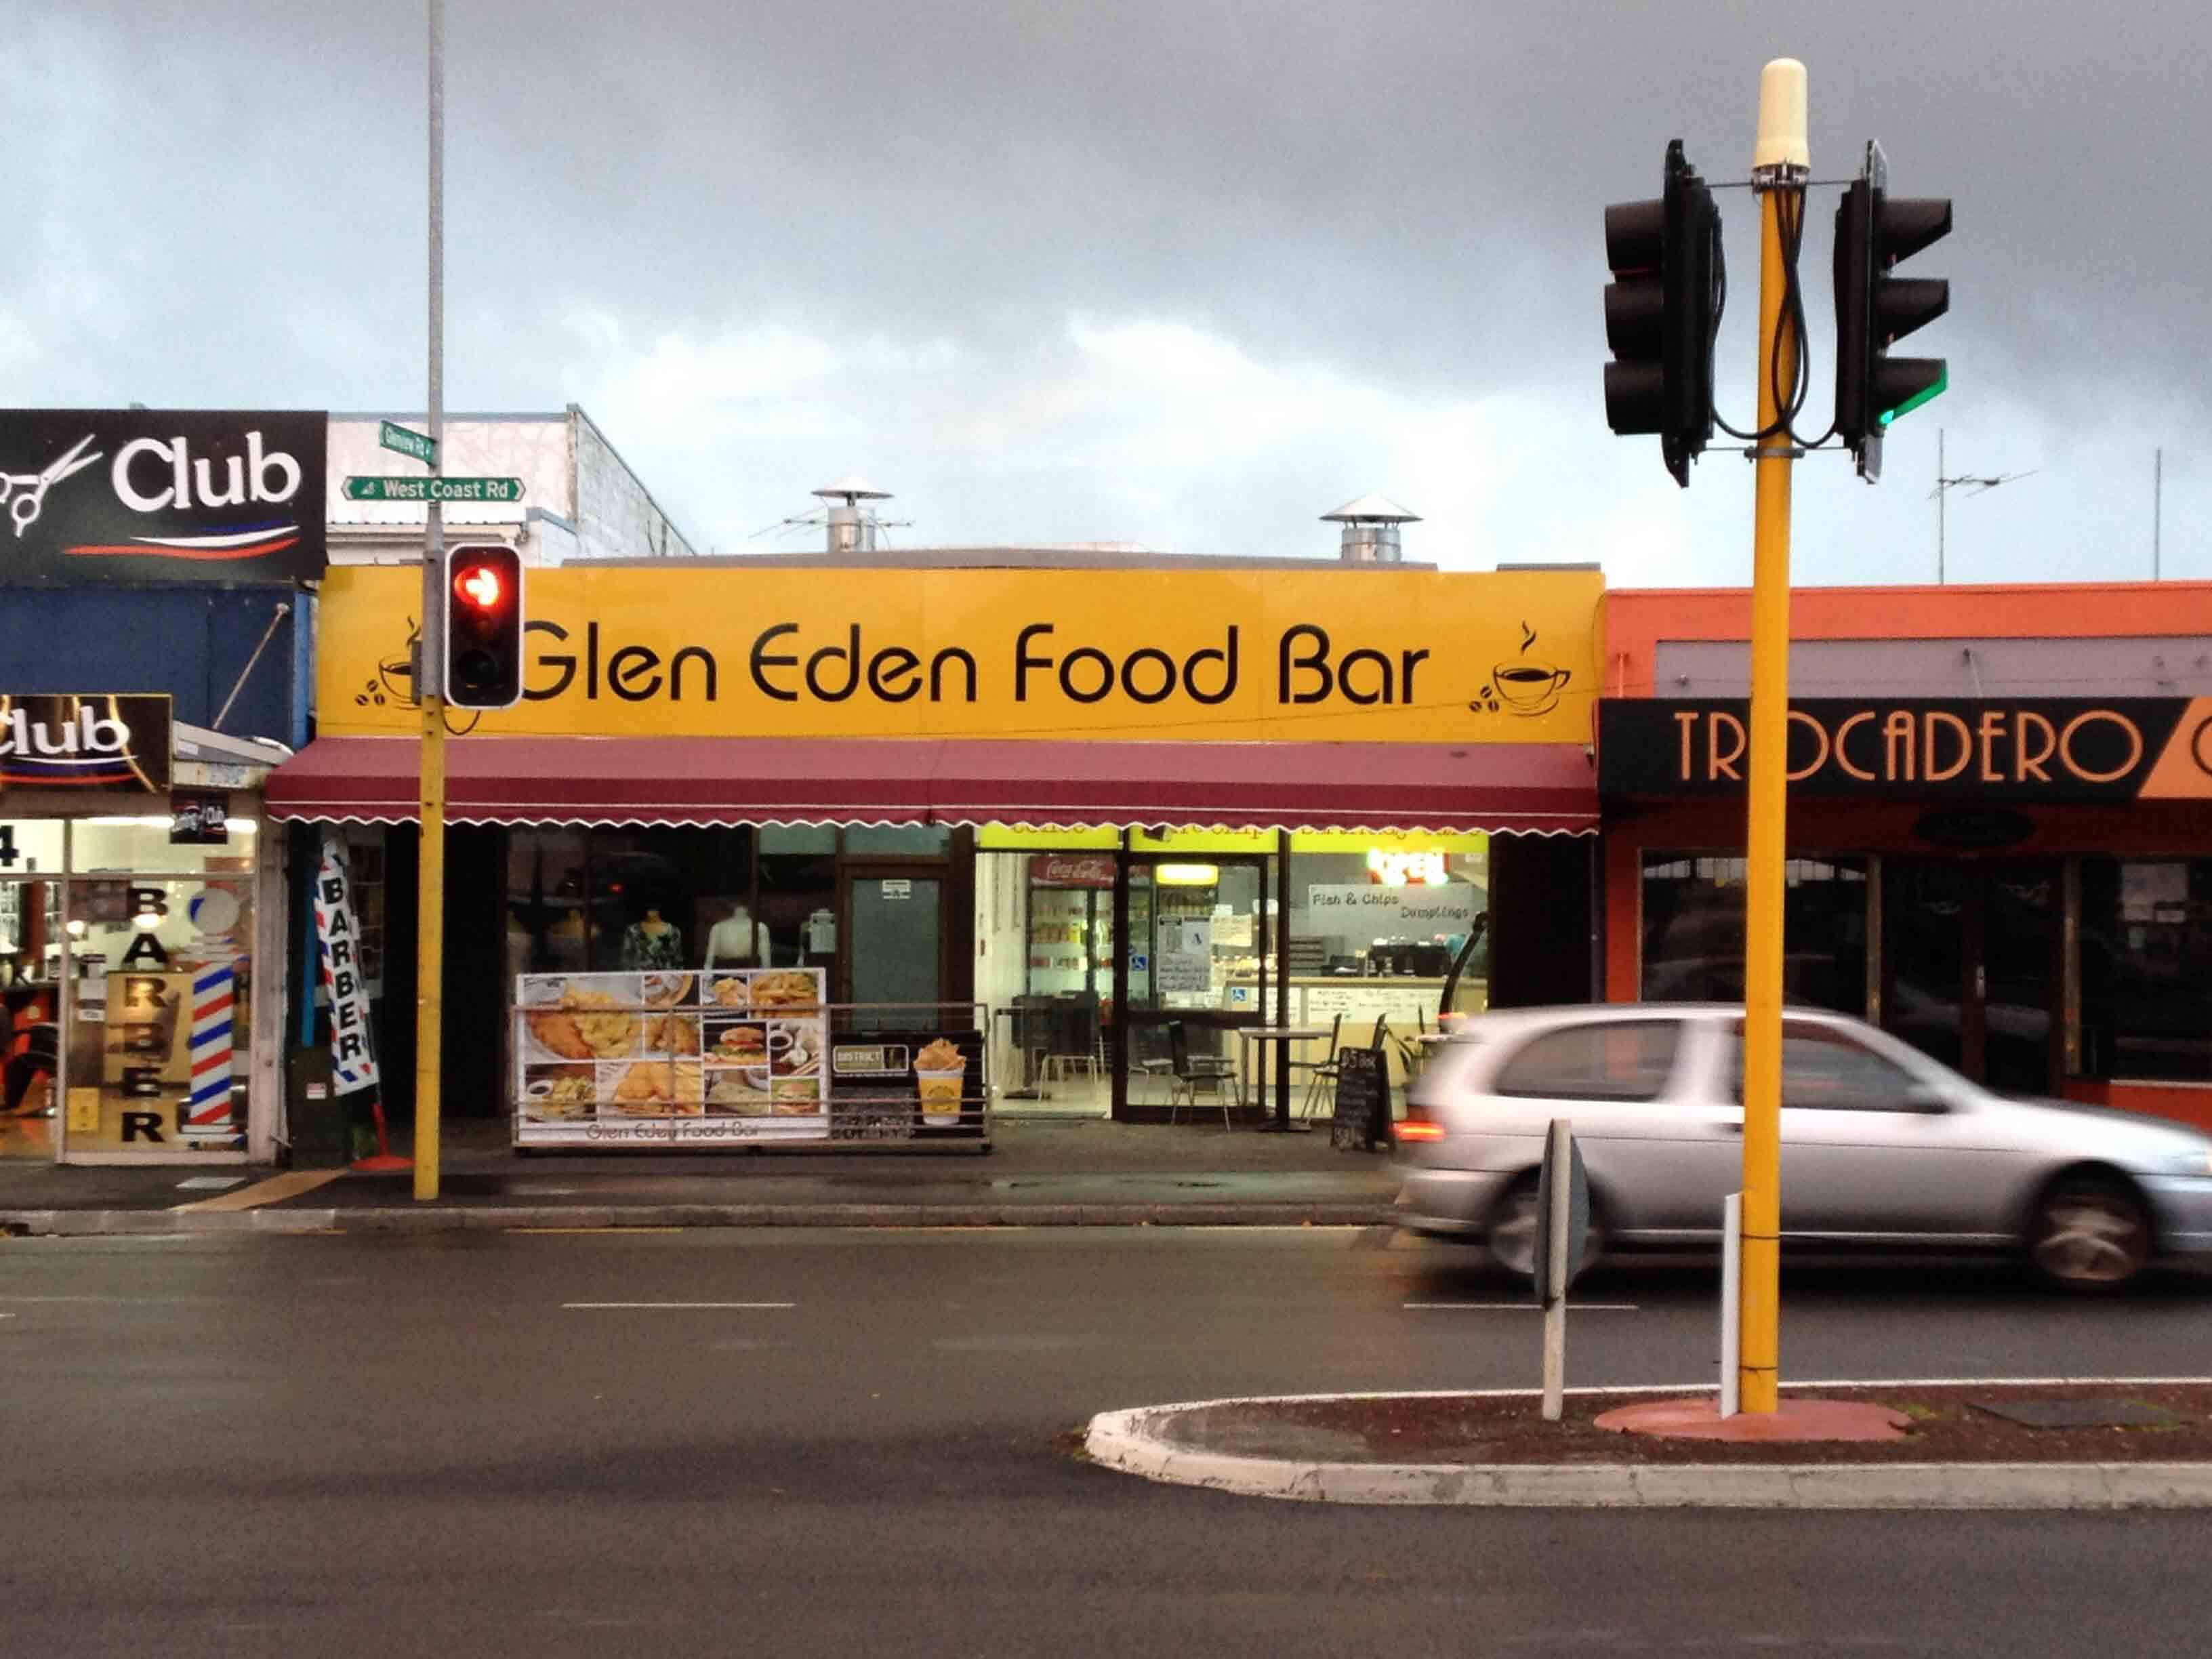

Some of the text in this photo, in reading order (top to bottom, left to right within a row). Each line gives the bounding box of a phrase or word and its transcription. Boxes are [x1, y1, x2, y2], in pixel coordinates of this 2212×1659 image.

[112, 431, 302, 512] Club
[382, 480, 508, 498] West Coast Rd
[523, 620, 1430, 704] Glen Eden Food Bar
[0, 705, 130, 755] lub
[1312, 891, 1399, 906] Fish & Chips
[1401, 905, 1469, 920] Dumplings
[323, 878, 363, 1062] BARBER
[121, 887, 170, 1143] BARBER
[586, 1123, 630, 1139] Glen
[682, 1122, 725, 1138] Food
[731, 1121, 759, 1136] Bar
